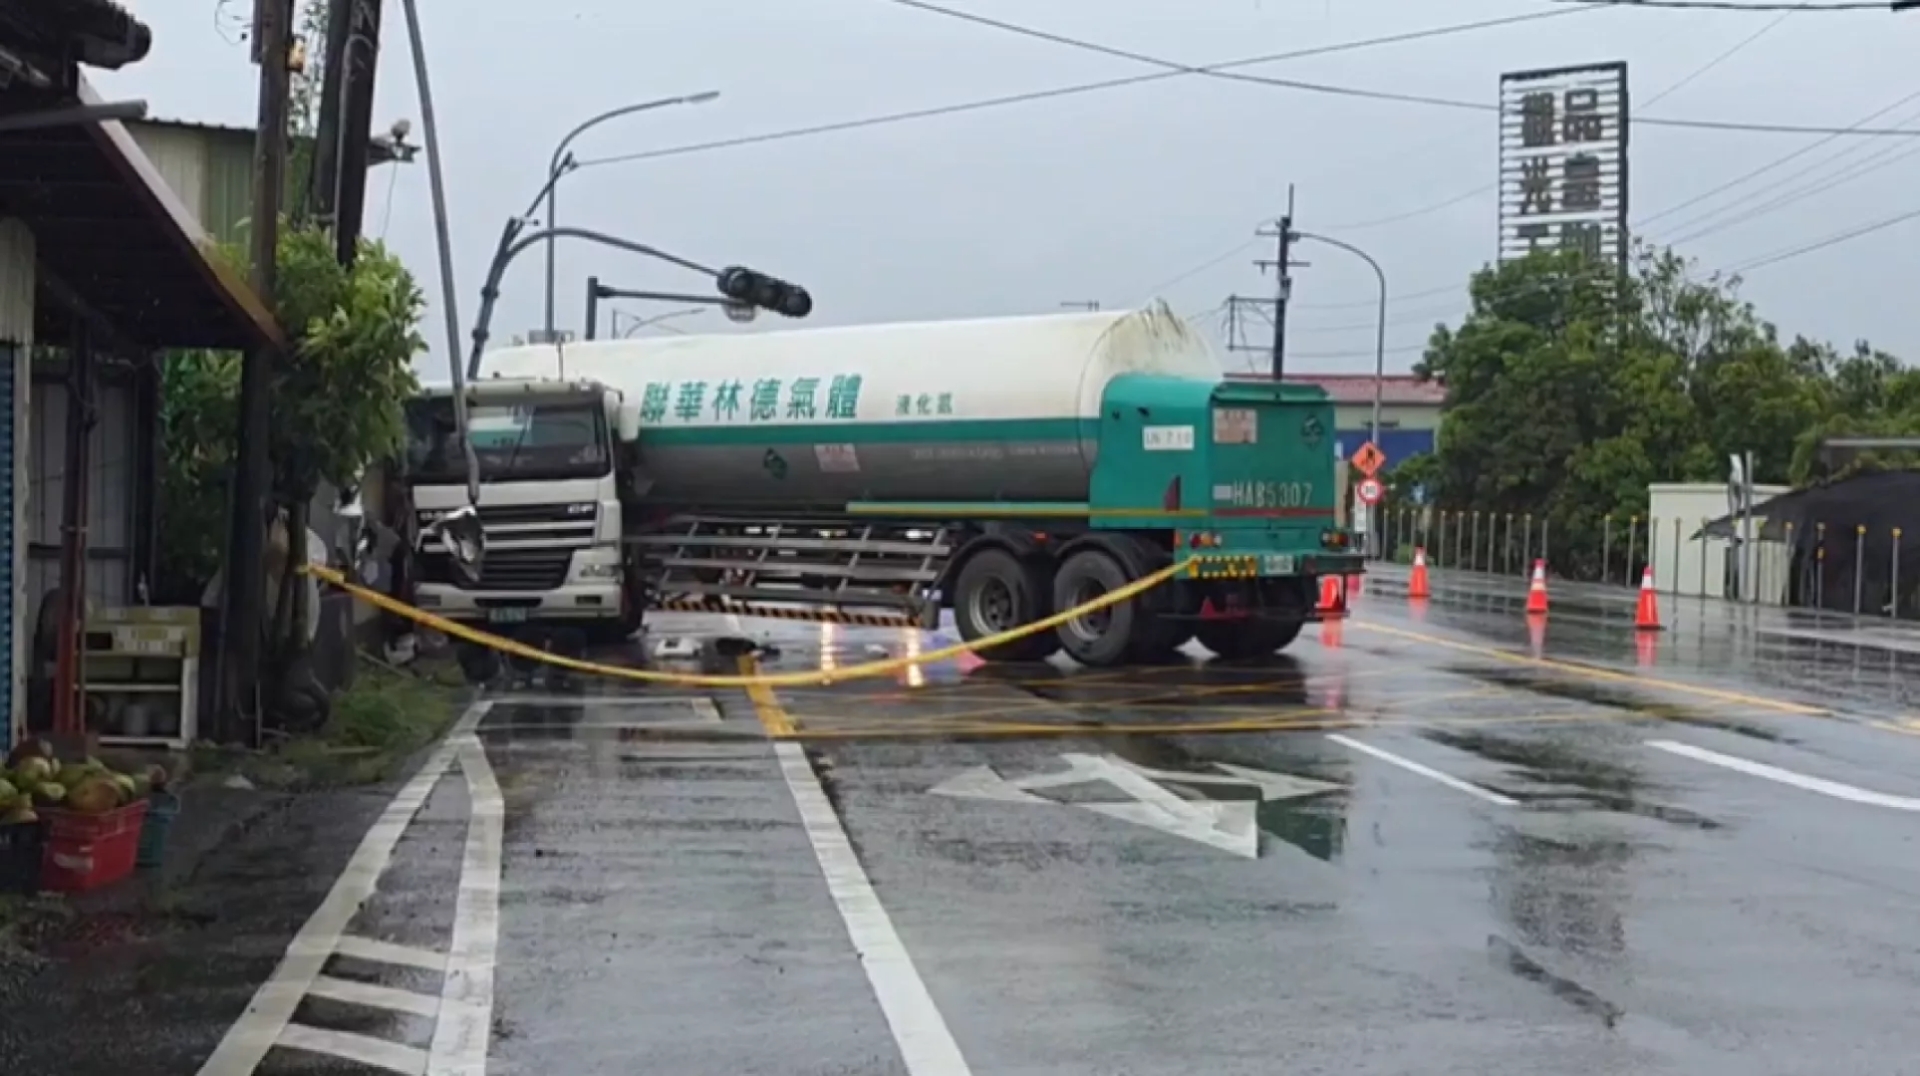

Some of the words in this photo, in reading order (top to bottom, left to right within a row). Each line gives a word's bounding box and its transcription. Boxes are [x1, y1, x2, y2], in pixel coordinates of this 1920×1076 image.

[639, 373, 862, 424] 聯華林德氣體
